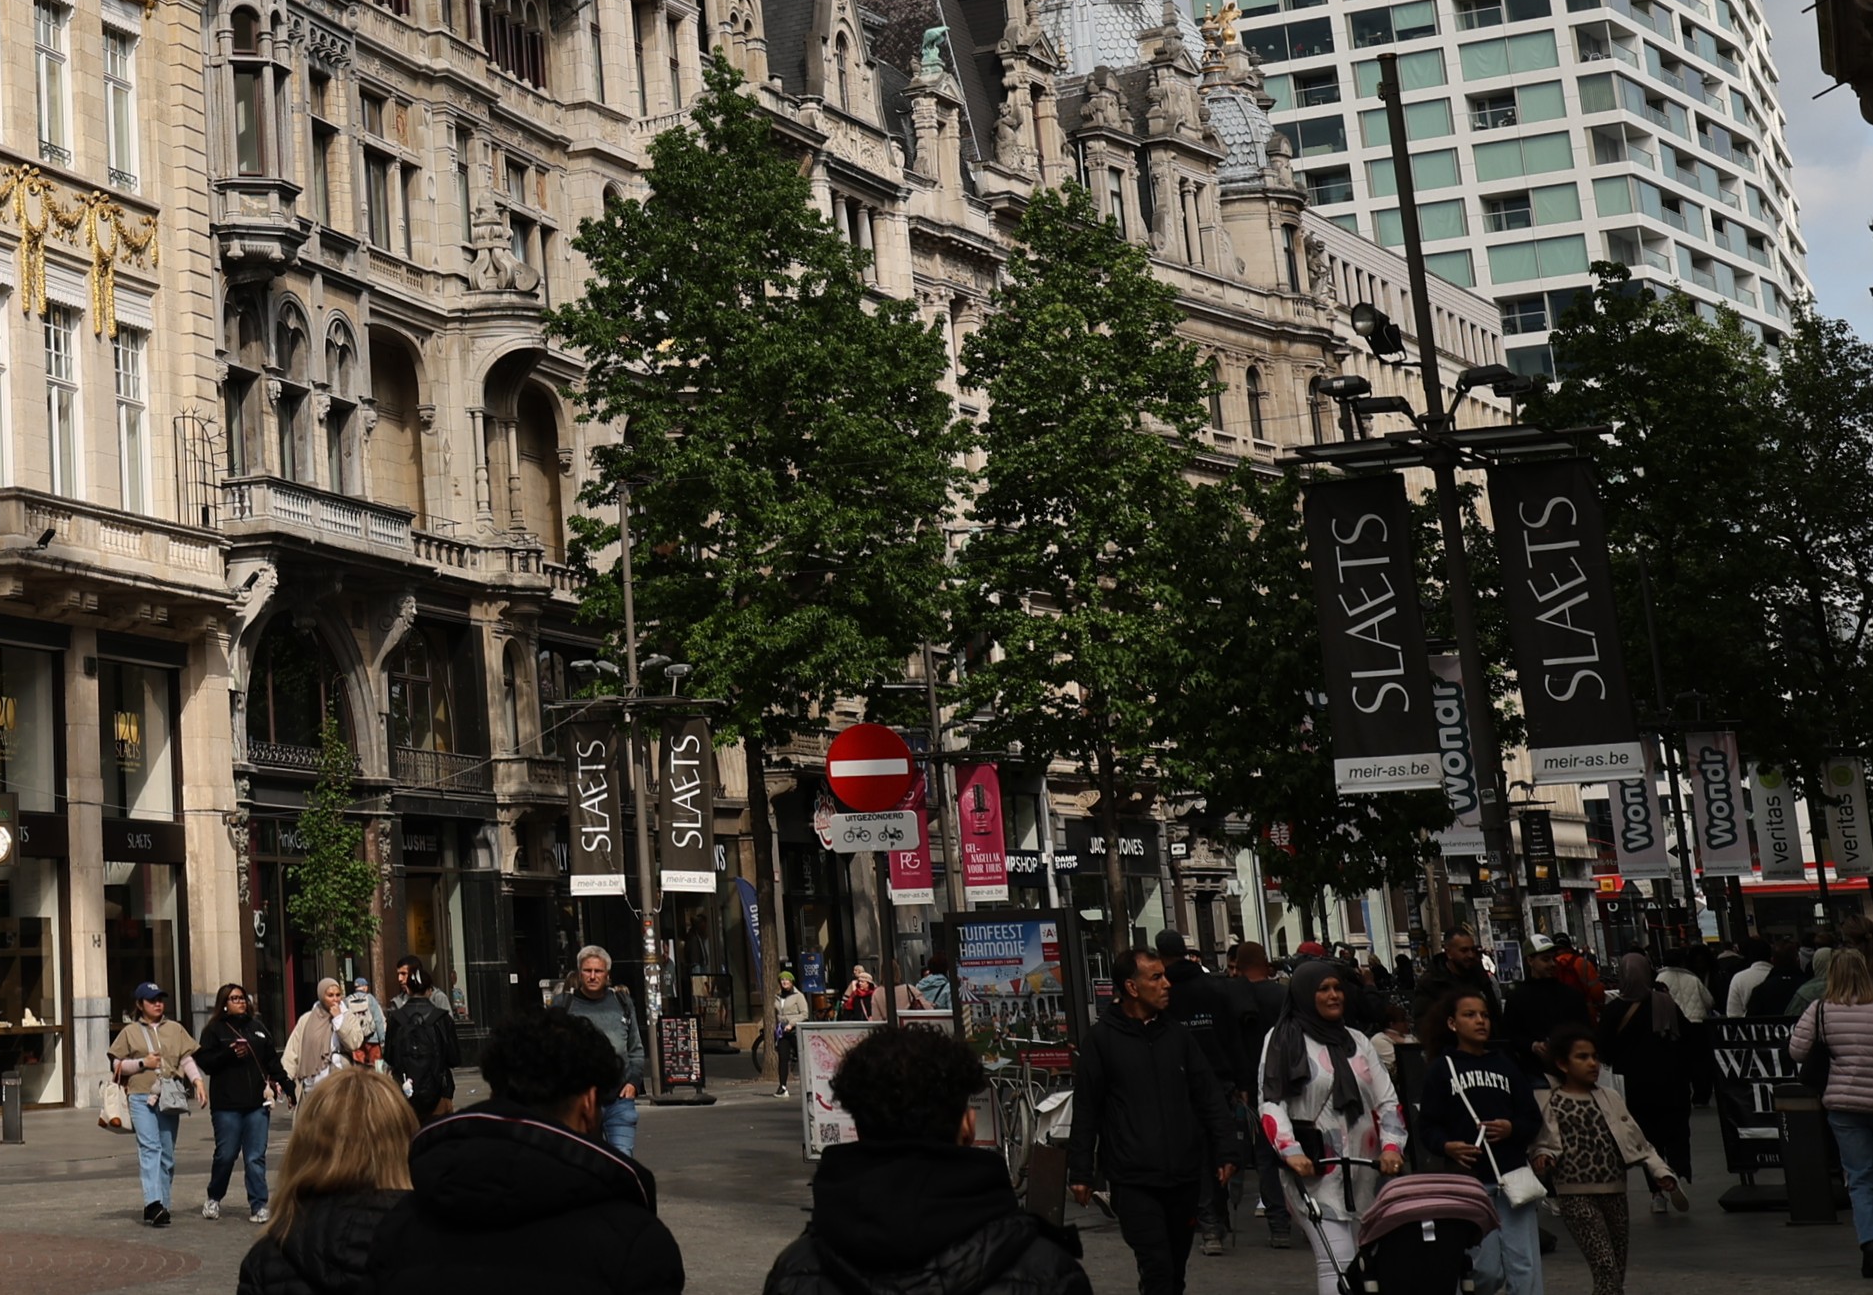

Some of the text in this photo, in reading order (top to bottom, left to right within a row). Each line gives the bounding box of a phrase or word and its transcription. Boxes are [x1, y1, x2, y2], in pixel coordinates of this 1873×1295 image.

[1518, 496, 1606, 701] SLAETS
[1331, 513, 1410, 714] SLAETS
[114, 711, 140, 744] 120
[115, 743, 140, 760] SLAETS
[1544, 751, 1629, 770] meir-as.be
[1349, 761, 1430, 780] meir-as.be
[576, 739, 612, 852] SLAETS
[670, 735, 703, 849] SLAETS
[1697, 746, 1737, 850] wondr
[845, 812, 904, 822] UITGEZONDERD
[1620, 780, 1654, 853] won
[1766, 796, 1788, 864] veritas
[1837, 793, 1859, 862] veritas
[128, 833, 152, 850] SLAETS
[402, 834, 426, 852] LUSH
[965, 844, 981, 854] GEL-
[1090, 837, 1106, 855] JAC
[971, 853, 1001, 864] NAGELLAK
[1055, 855, 1077, 863] DAMP
[1055, 862, 1078, 870] SHOP
[967, 863, 1002, 874] VOOR THUIS
[578, 878, 619, 888] meir-as.be
[666, 875, 709, 884] meir-as.be
[897, 891, 929, 899] meir-as.be
[957, 924, 1024, 942] TUINFEEST
[959, 940, 1026, 957] HARMONIE
[1717, 1023, 1795, 1042] TATTO
[1713, 1048, 1803, 1079] WAL
[1450, 1070, 1511, 1097] MANHATTA
